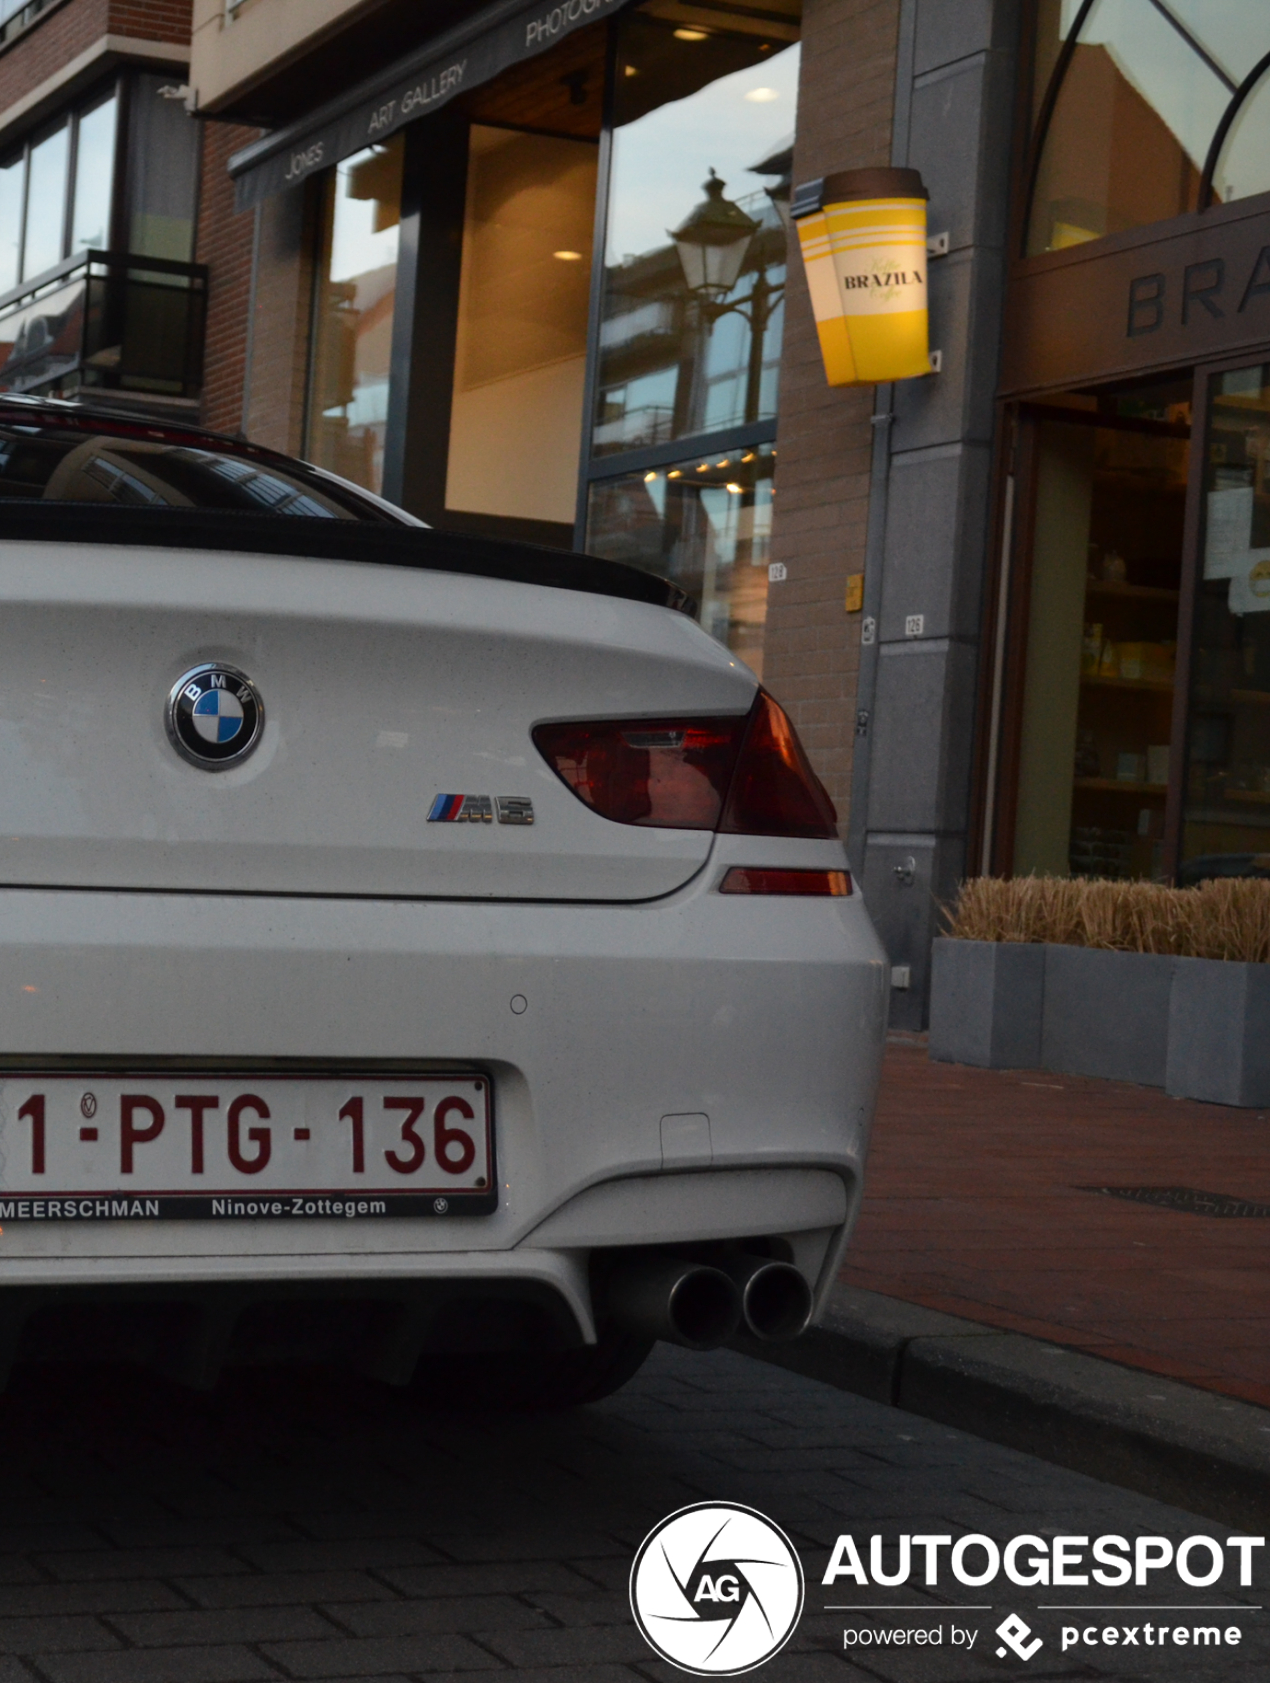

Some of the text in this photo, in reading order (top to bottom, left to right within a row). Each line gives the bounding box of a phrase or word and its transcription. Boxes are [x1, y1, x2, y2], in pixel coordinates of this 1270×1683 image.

[285, 141, 325, 180] JONES
[367, 99, 396, 135] ART
[401, 58, 468, 114] GALLERY
[844, 269, 923, 290] BRAZILA
[907, 617, 921, 633] 126
[184, 673, 252, 705] BMW
[212, 1198, 387, 1217] Ninove-Zottegem
